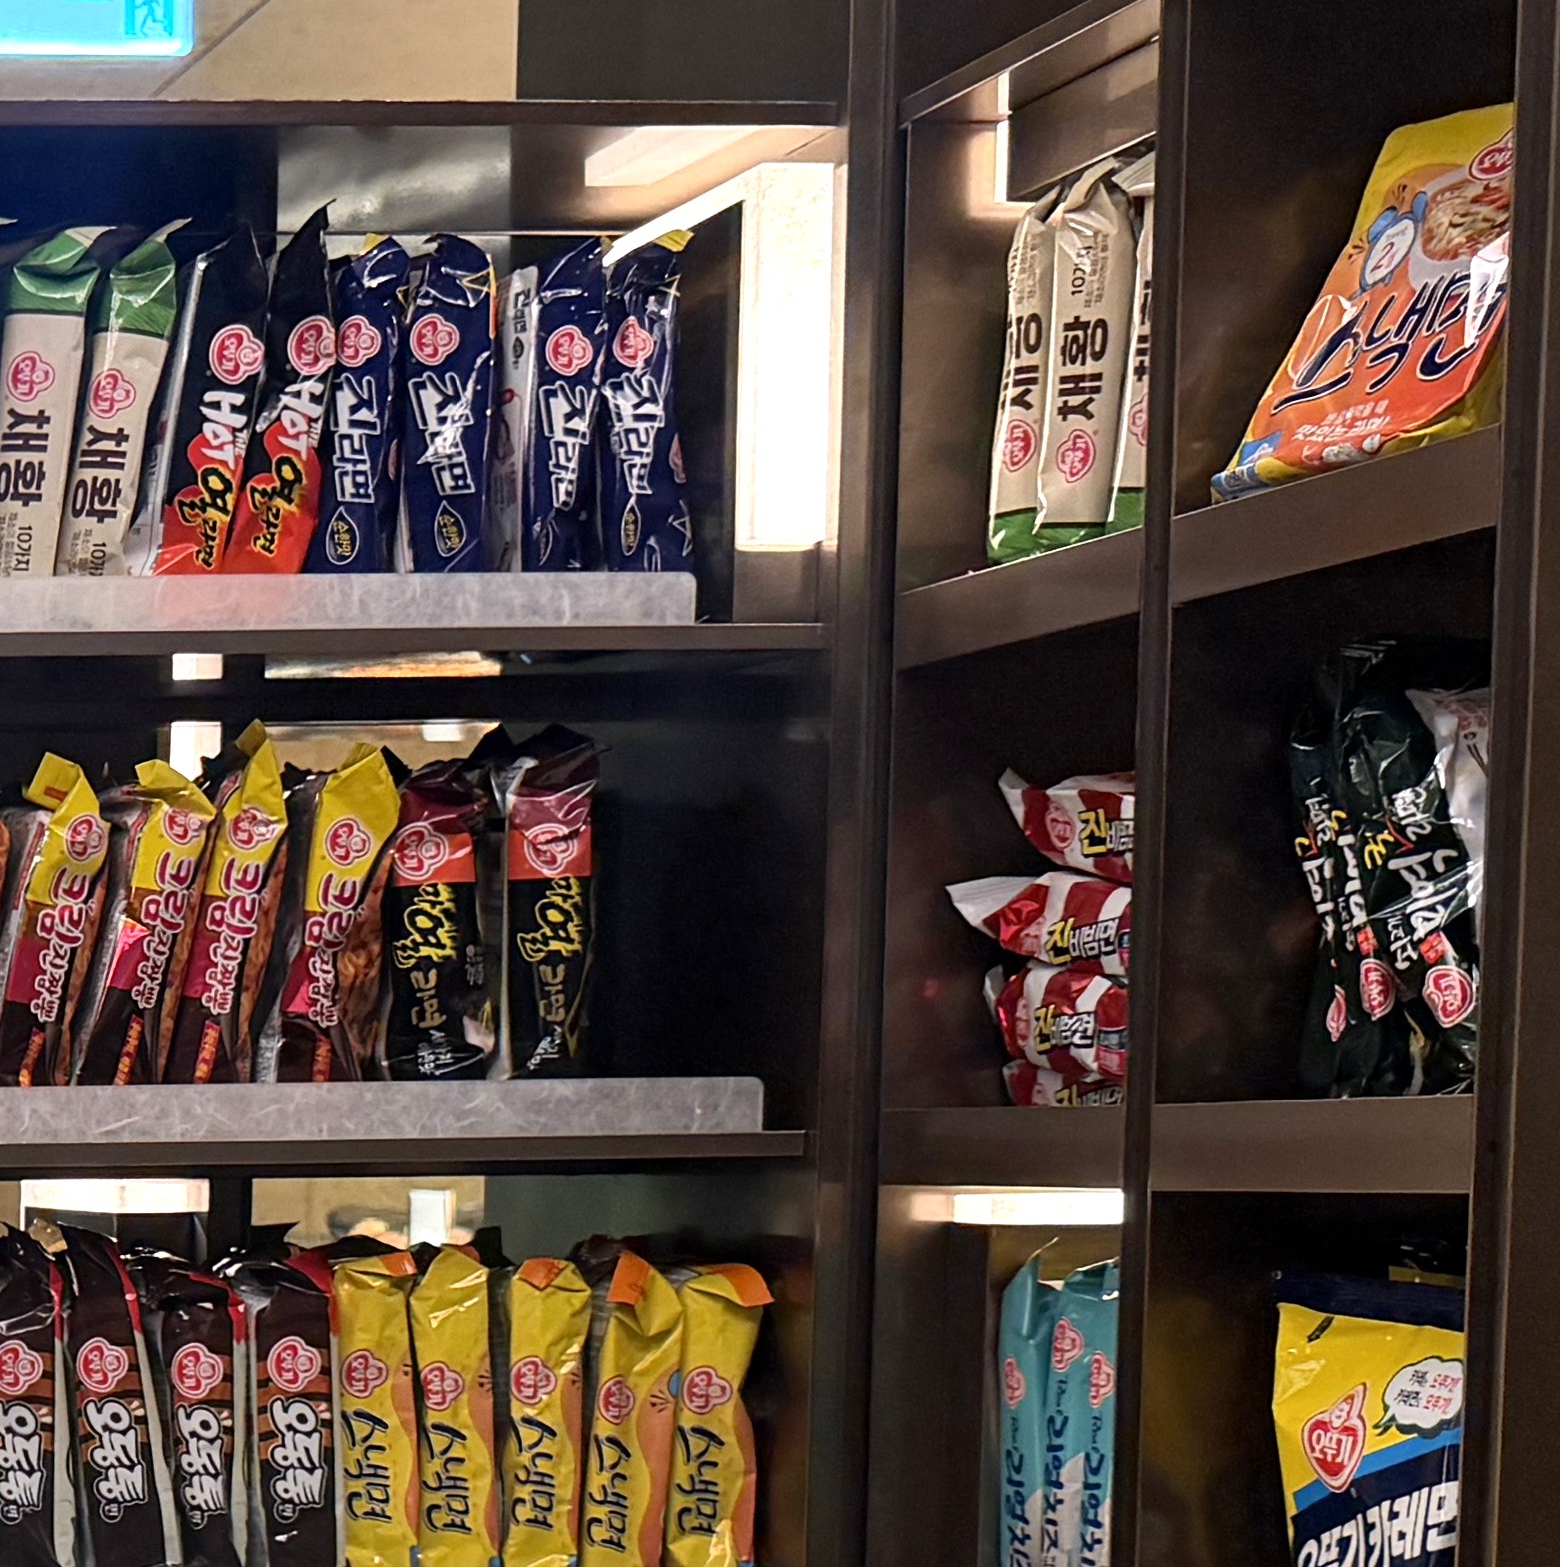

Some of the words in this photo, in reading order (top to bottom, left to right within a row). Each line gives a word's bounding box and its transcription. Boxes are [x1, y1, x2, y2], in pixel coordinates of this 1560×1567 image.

[1057, 315, 1109, 422] 채황
[72, 426, 130, 524] 채황
[331, 373, 379, 503] 진라면
[409, 372, 475, 495] 진라면
[540, 381, 597, 510] 진라면
[607, 373, 664, 495] 진라면
[12, 524, 33, 572] 10가지
[31, 867, 87, 1023] 크림진짬뽕
[131, 851, 195, 1009] 크림진짬뽕
[202, 856, 263, 1016] 크림진짬뽕
[305, 873, 358, 1028] 크림진짬뽕
[1045, 917, 1119, 967] 진비빔면
[84, 1397, 148, 1523] 오동통면
[268, 1396, 328, 1523] 오동통면
[342, 1409, 393, 1523] 스낵면
[422, 1422, 473, 1535] 스낵면
[505, 1415, 558, 1530] 스낵면
[586, 1434, 633, 1553] 스낵면
[678, 1425, 725, 1535] 스낵면
[1310, 1429, 1352, 1466] 오뚜기
